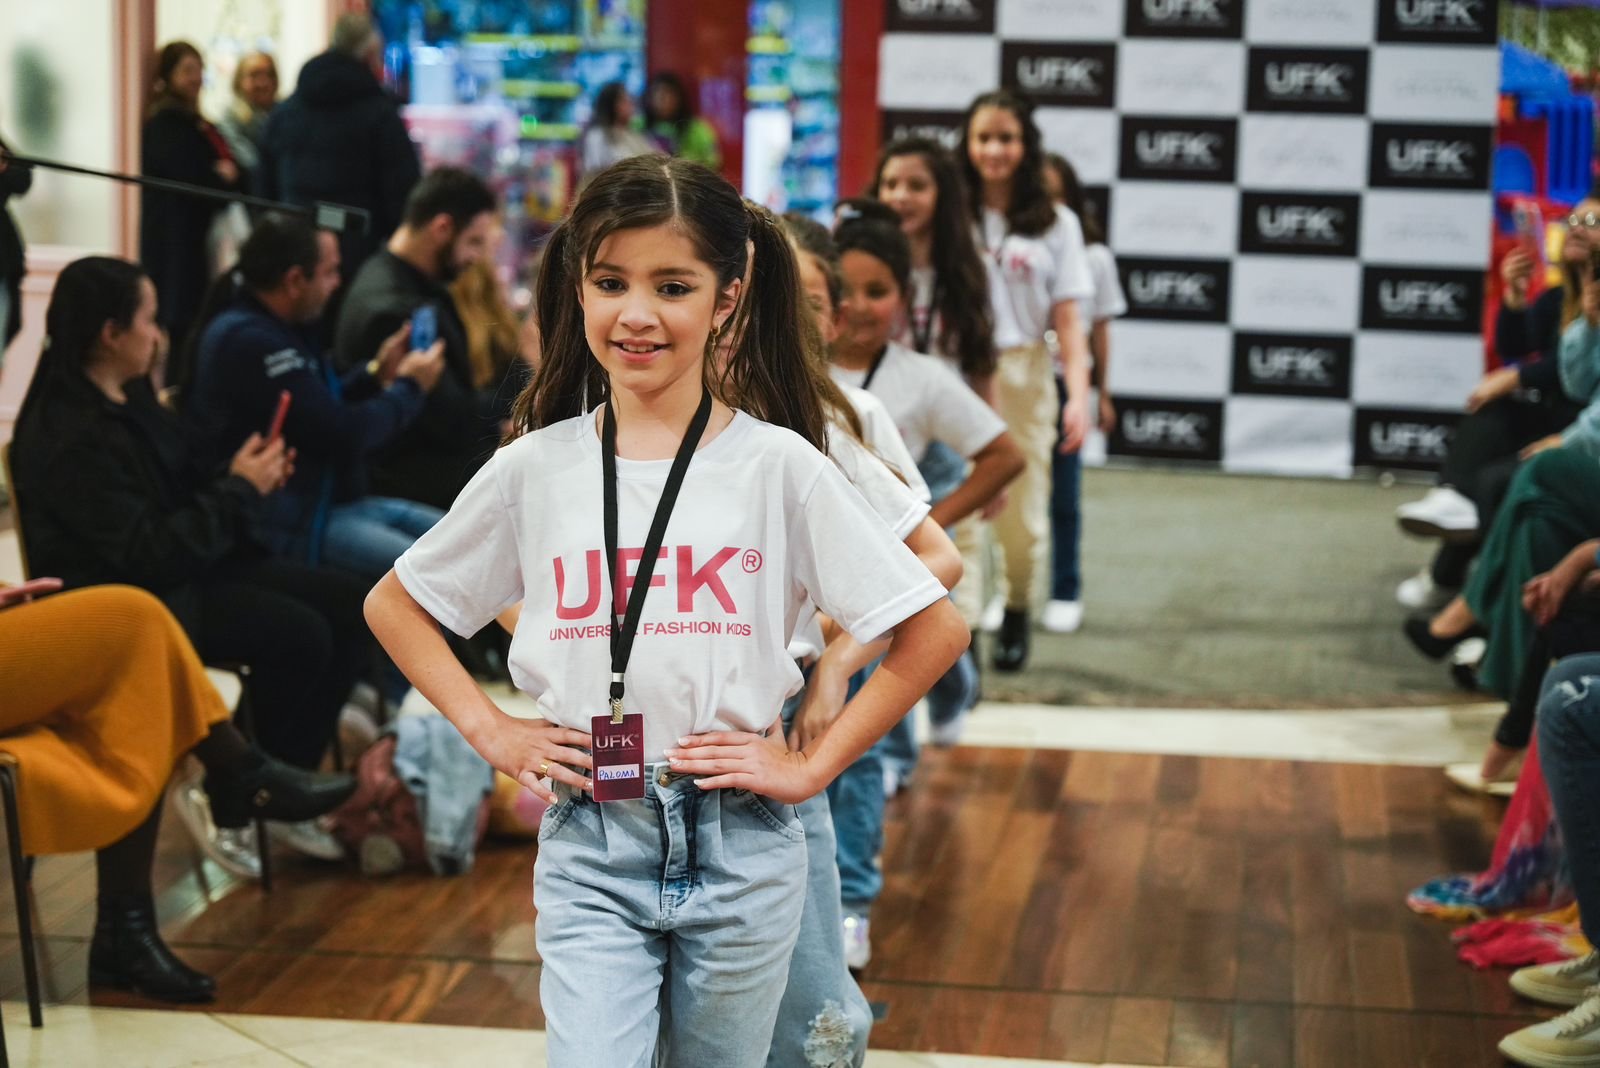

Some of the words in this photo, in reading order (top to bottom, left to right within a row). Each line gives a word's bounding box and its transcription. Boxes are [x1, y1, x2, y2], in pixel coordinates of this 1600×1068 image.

[1016, 57, 1097, 90] UFK
[1265, 63, 1345, 95] UFK
[1135, 131, 1216, 165] UFK
[1386, 140, 1466, 173] UFK
[1257, 206, 1337, 239] UFK
[1129, 271, 1209, 305] UFK
[1379, 281, 1459, 315] UFK
[1249, 346, 1328, 380] UFK
[1122, 411, 1202, 445] UFK
[549, 622, 638, 641] UNIVERS
[643, 621, 721, 636] FASHION
[726, 621, 752, 637] KIDS
[598, 769, 636, 780] PALOMA
